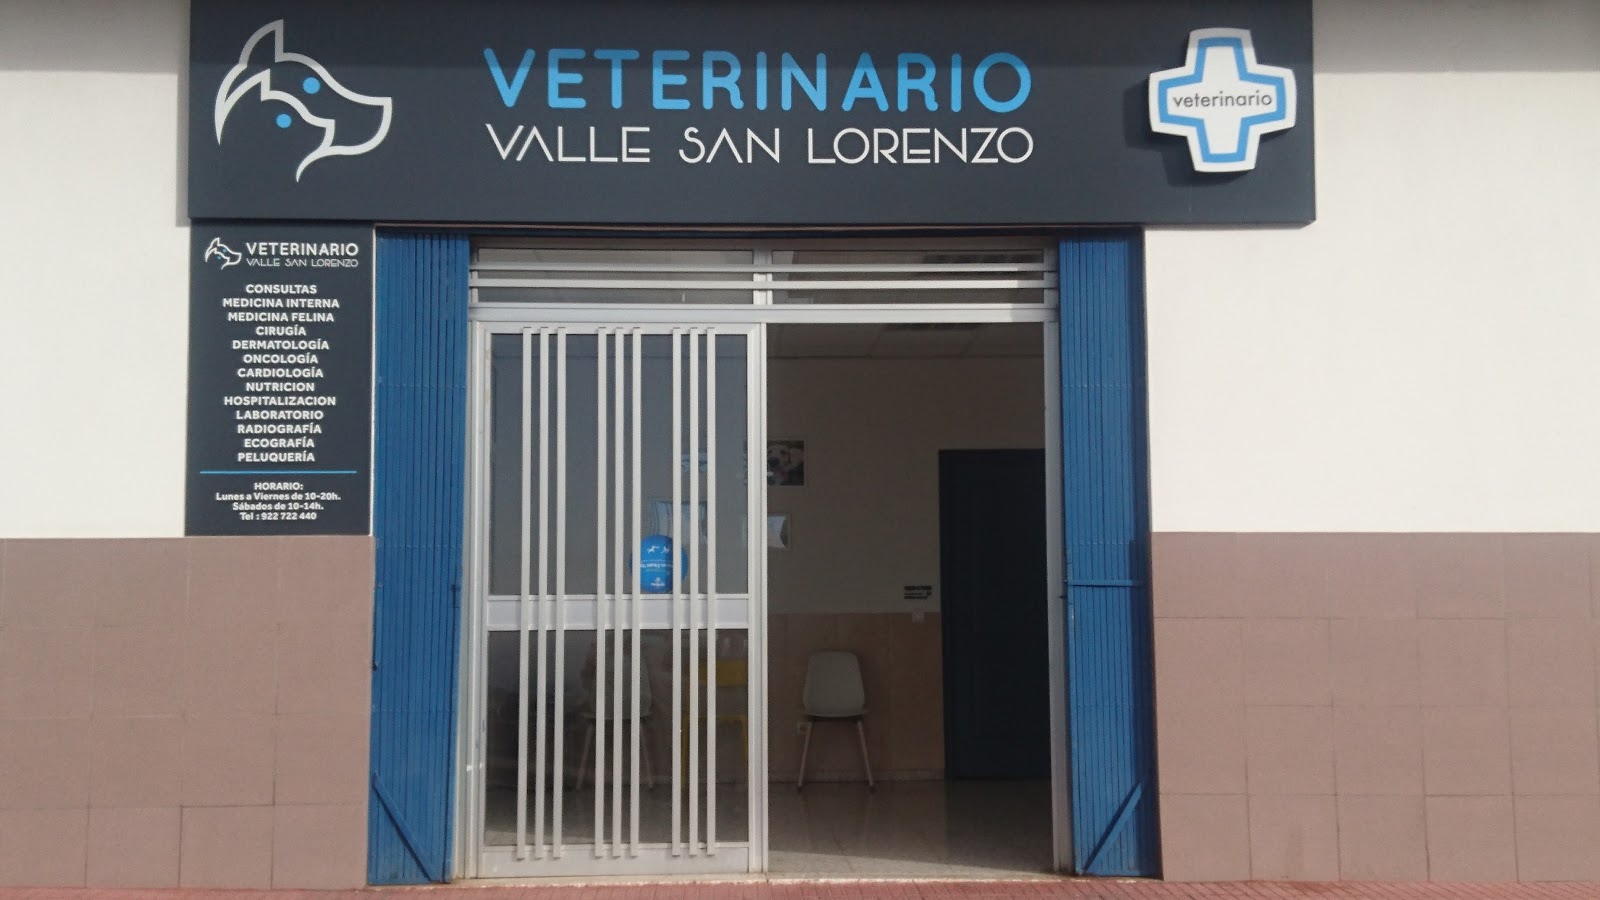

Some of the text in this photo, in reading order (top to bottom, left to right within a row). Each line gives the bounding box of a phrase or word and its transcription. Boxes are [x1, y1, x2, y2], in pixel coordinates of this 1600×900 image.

[483, 48, 1032, 113] VETERINARIO
[1173, 90, 1273, 108] veterinario
[485, 124, 1034, 164] VALLE SAN LORENZO
[245, 242, 360, 256] VETERINARIO
[245, 258, 359, 268] VALLE SAN LORENZO
[245, 284, 318, 294] CONSULTAS
[222, 298, 340, 309] MEDICINA INTERNA
[227, 312, 335, 322] MEDICINA FELINA
[255, 324, 307, 336] CIRUGÍA
[232, 338, 330, 350] DERMATOLOGÍA
[243, 352, 319, 364] ONCOLOGÍA
[237, 366, 324, 378] CARDIOLOGÍA
[245, 382, 316, 392] NUTRICION
[223, 396, 337, 406] HOSPITALIZACION
[235, 409, 324, 420] LABORATORIO
[237, 422, 323, 434] RADIOGRAFÍA
[243, 436, 316, 448] ECOGRAFÍA
[237, 450, 316, 463] PELUQUERÍA
[253, 482, 304, 491] HORARIO:
[215, 492, 244, 501] Lunes
[253, 492, 290, 501] Viernes
[291, 492, 303, 501] de
[305, 492, 342, 501] 10-20h.
[232, 502, 324, 511] Sábados de 10-14h.
[261, 511, 279, 521] 922
[281, 511, 298, 521] 722
[299, 511, 318, 521] 440
